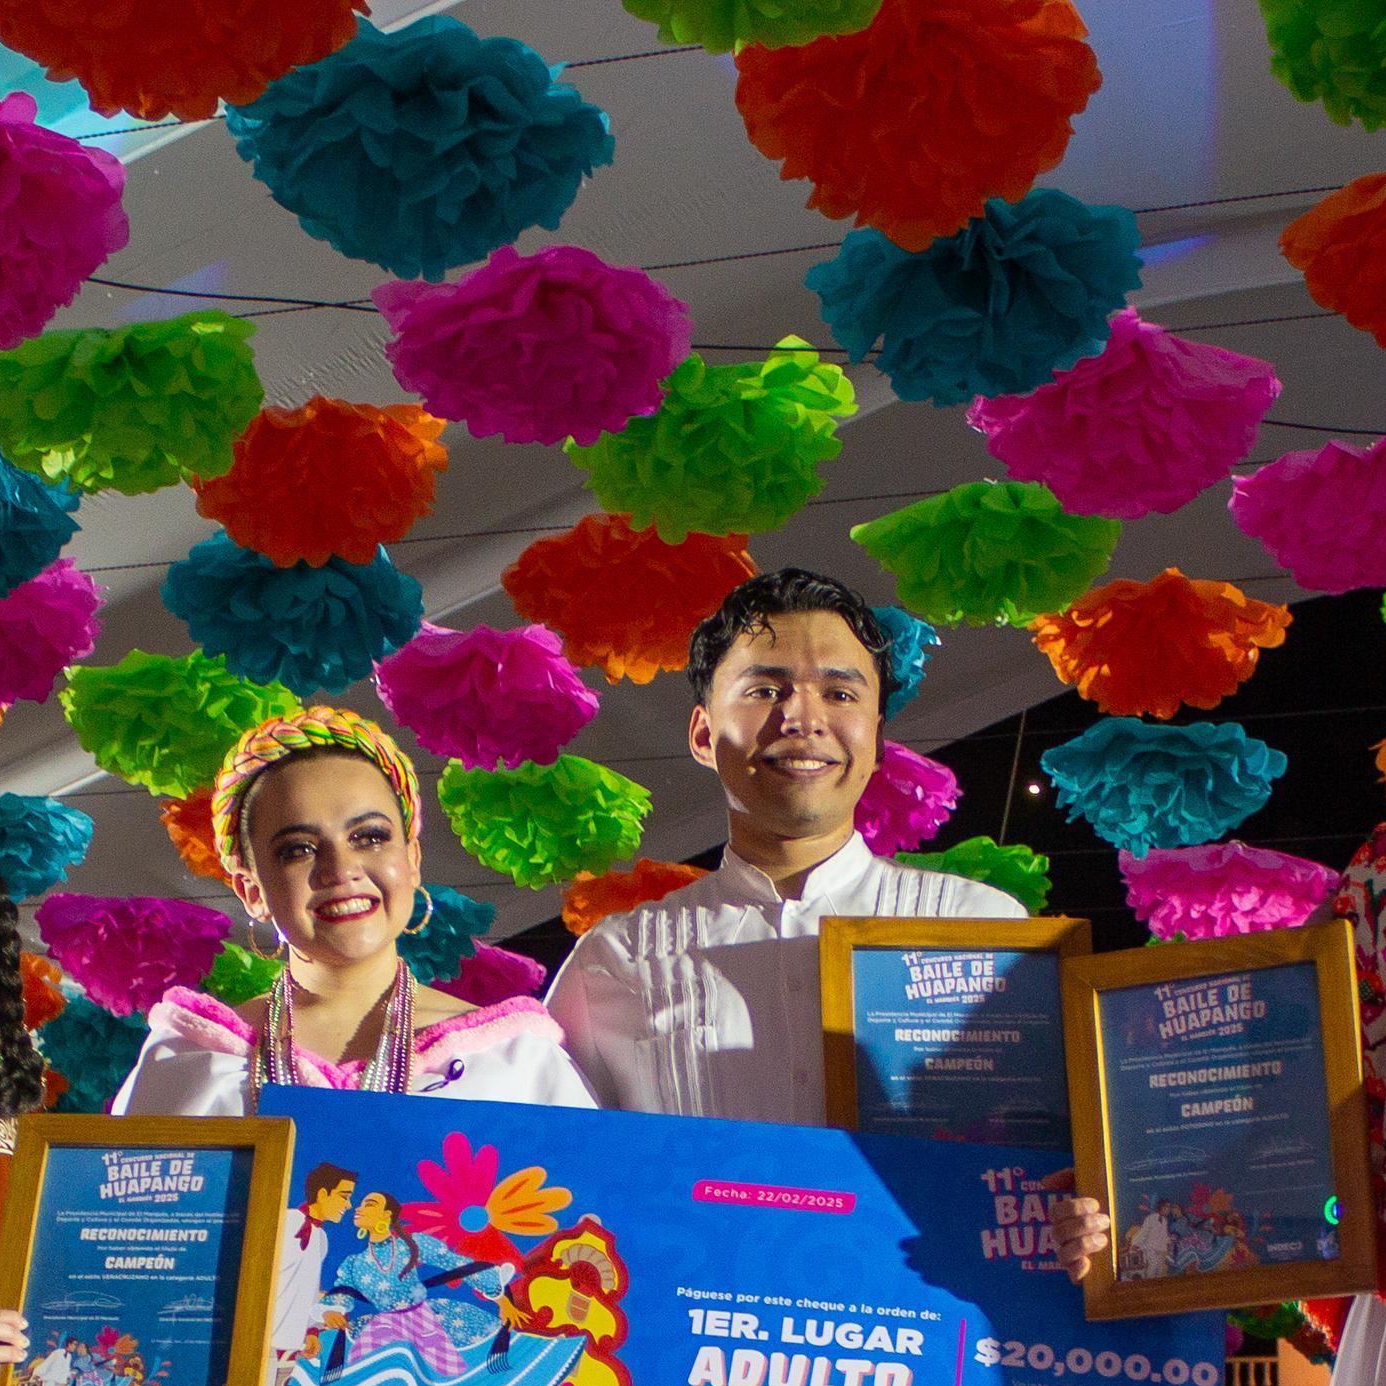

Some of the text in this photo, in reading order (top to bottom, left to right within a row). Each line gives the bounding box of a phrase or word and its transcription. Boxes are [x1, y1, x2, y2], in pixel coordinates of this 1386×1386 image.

[910, 961, 994, 982] BAILE DE
[905, 977, 1007, 1000] HUAPANGO
[1163, 983, 1252, 1018] BAILE DE
[1159, 1000, 1268, 1039] HUAPANGO
[895, 1029, 1021, 1043] RECONOCIMIENTO
[925, 1056, 994, 1071] CAMPEÓN
[1149, 1060, 1284, 1088] RECONOCIMIENTO
[1181, 1094, 1254, 1118] CAMPEÓN
[108, 1160, 194, 1181] BAILE DE
[100, 1176, 204, 1199] HUAPANGO
[155, 1193, 179, 1202] 2025
[705, 1186, 843, 1208] Fecha: 22/02/2025
[80, 1228, 208, 1241] RECONOCIMIENTO
[105, 1254, 175, 1269] CAMPEÓN
[677, 1287, 941, 1321] Páguese por este cheque a la orden de:
[688, 1309, 924, 1356] 1ER. LUGAR
